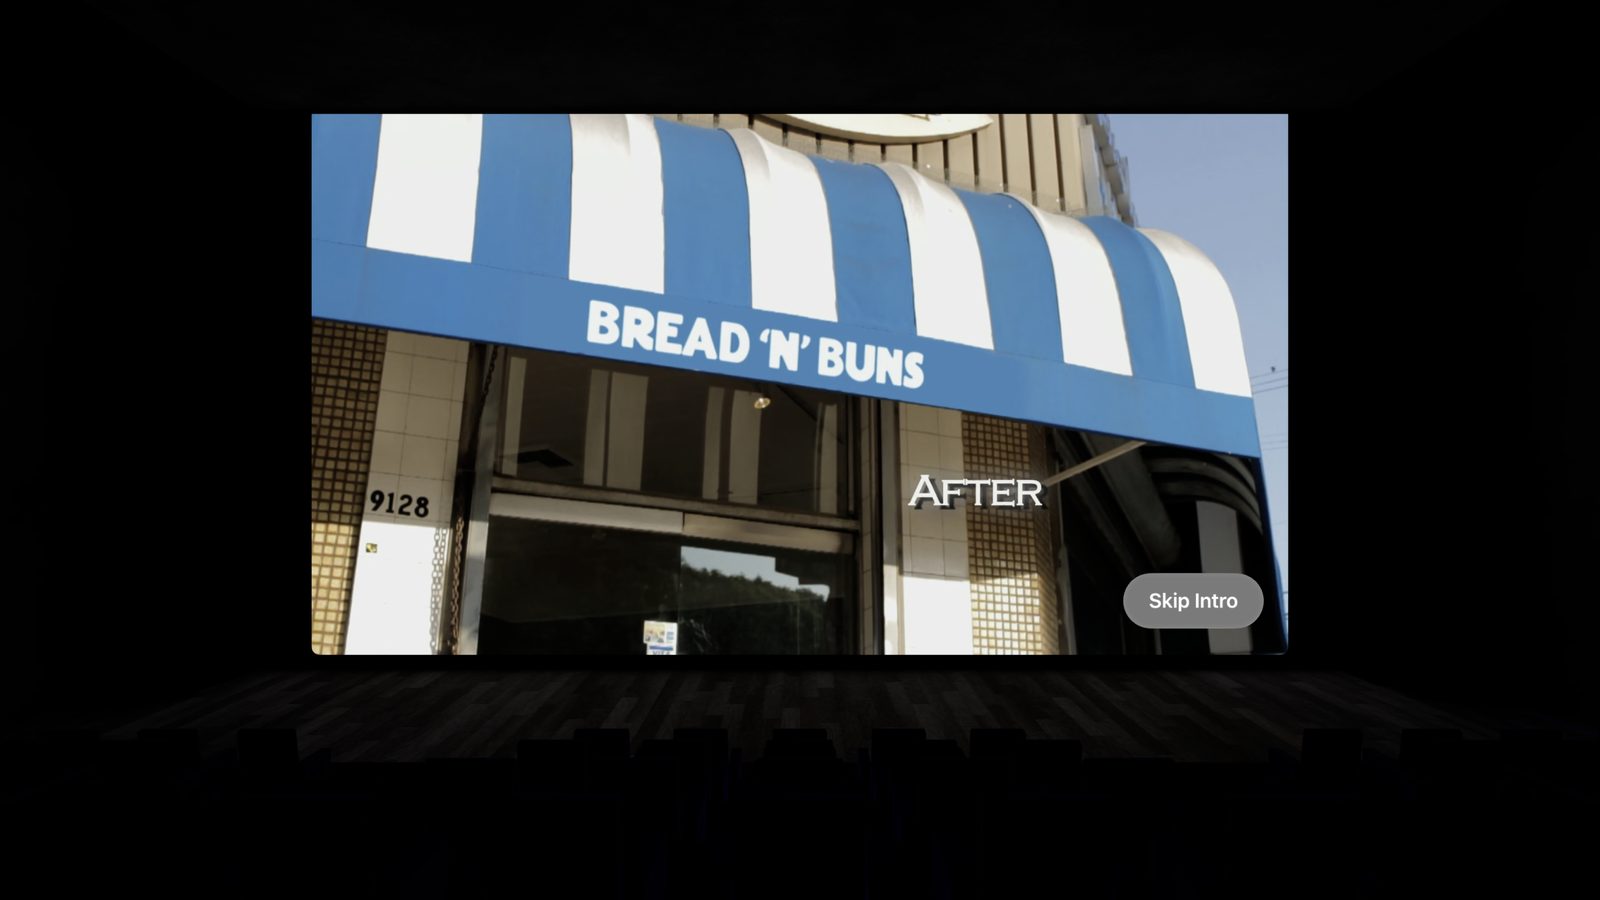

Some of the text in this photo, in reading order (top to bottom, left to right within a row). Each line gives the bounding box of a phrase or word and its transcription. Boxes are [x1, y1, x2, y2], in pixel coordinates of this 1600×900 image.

[586, 299, 751, 364] BREAD
[817, 337, 925, 389] BUNS
[369, 489, 431, 519] 9128
[1149, 591, 1239, 612] Skip Intro
